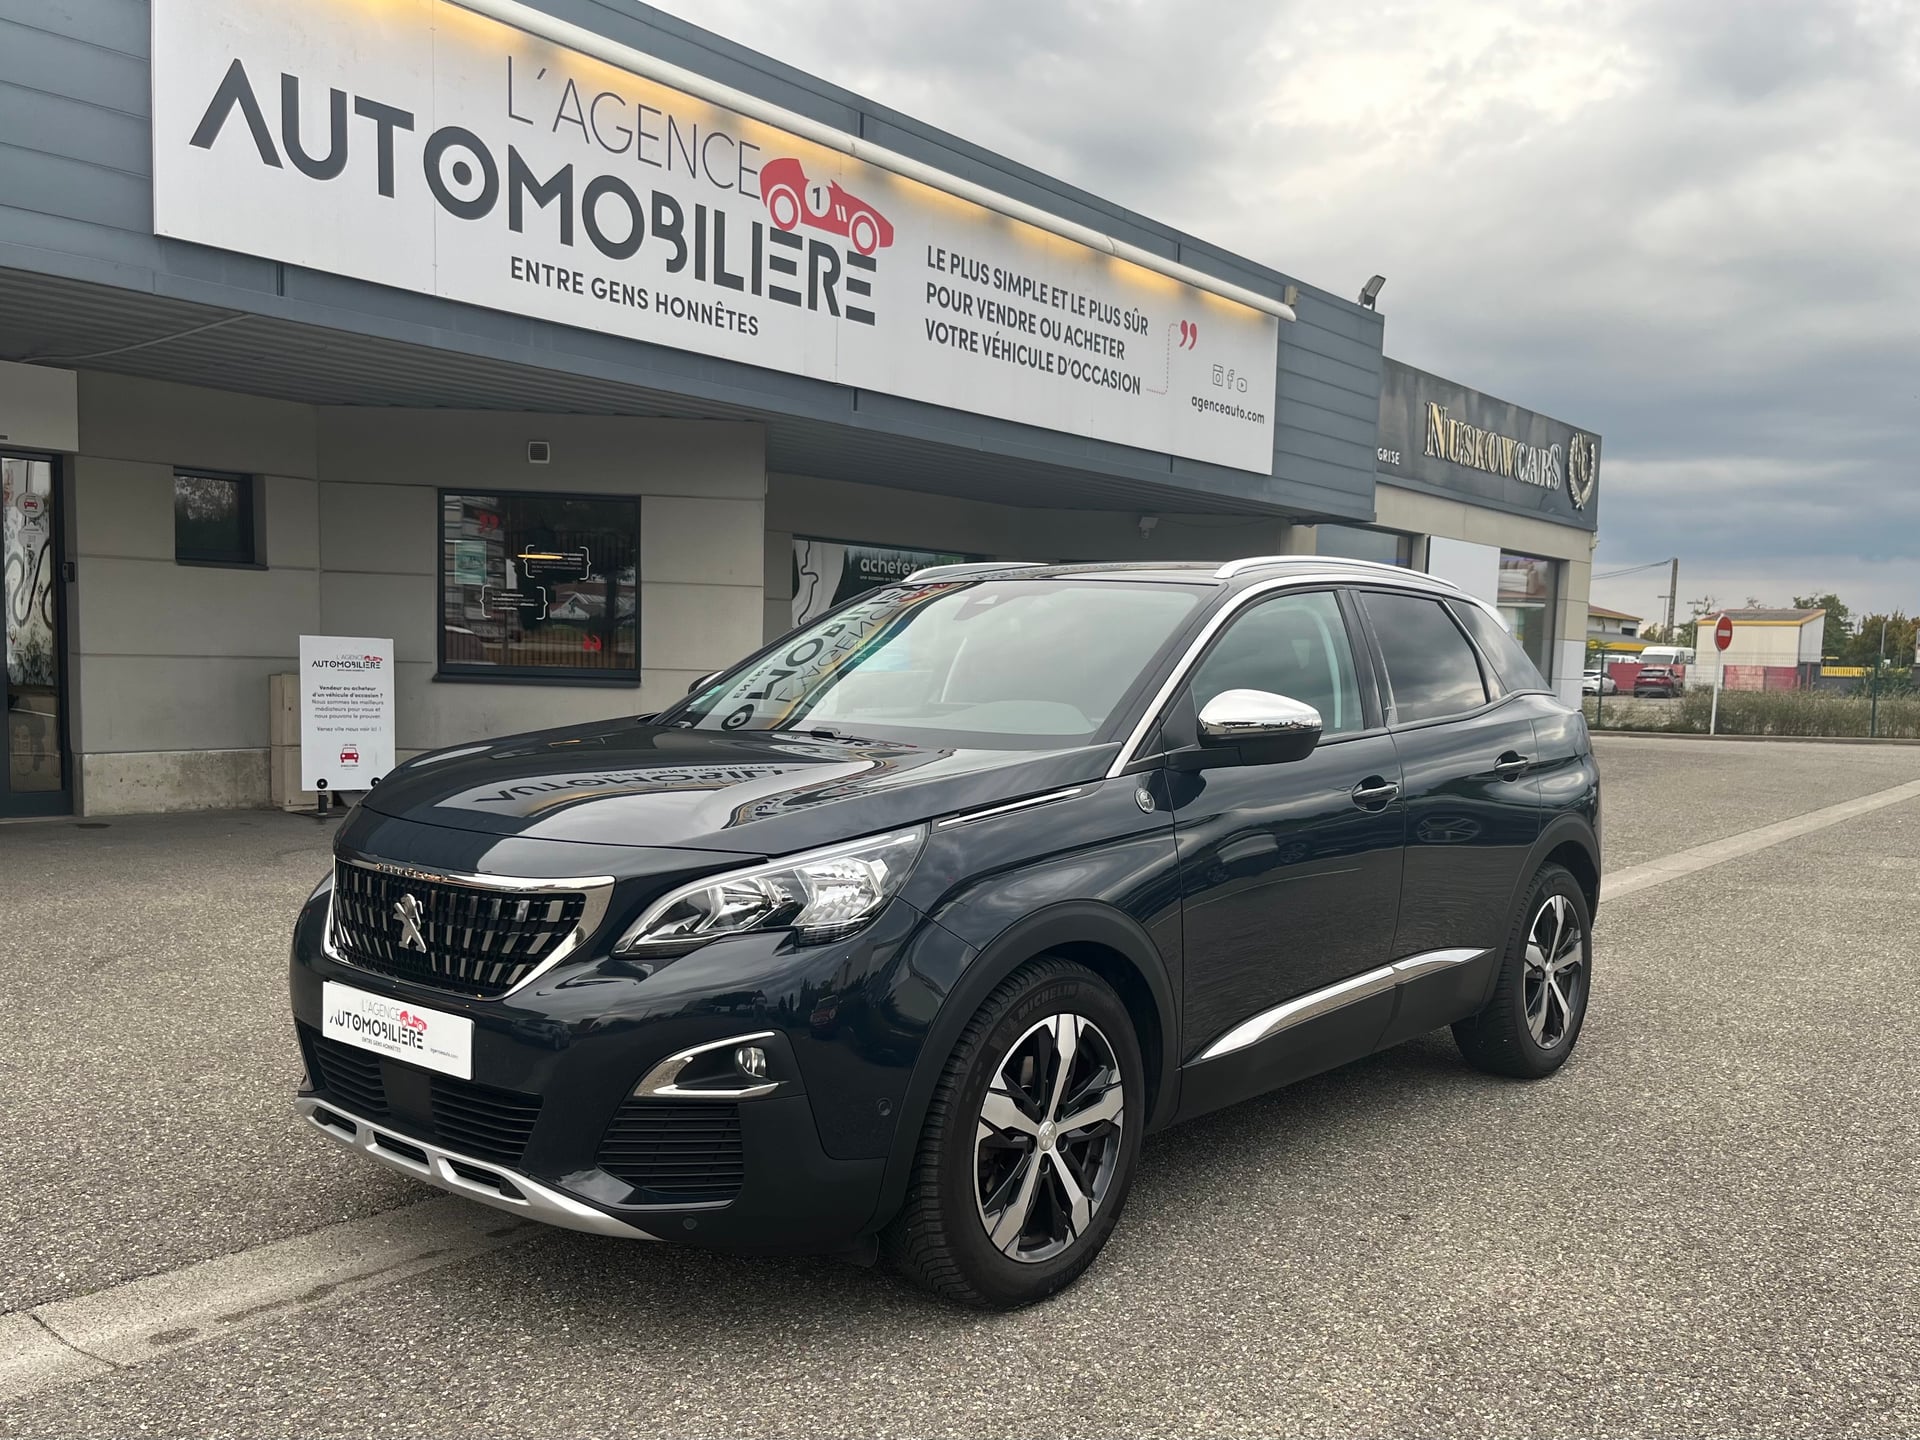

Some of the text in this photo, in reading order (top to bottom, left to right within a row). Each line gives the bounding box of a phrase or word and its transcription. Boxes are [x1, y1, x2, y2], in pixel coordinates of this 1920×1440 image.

[812, 186, 821, 210] 1
[511, 256, 759, 336] ENTRE GENS HONNÊTES
[927, 245, 1149, 336] LE PLUS SIMPLE ET LE PLUS SÛR
[926, 282, 1125, 360] POUR VENDRE OU ACHETER
[925, 318, 1141, 395] VOTRE VÉHICULE D'OCCASION
[1191, 395, 1265, 424] agenceauto.com
[1377, 447, 1400, 465] GRISE
[860, 558, 918, 576] achetez
